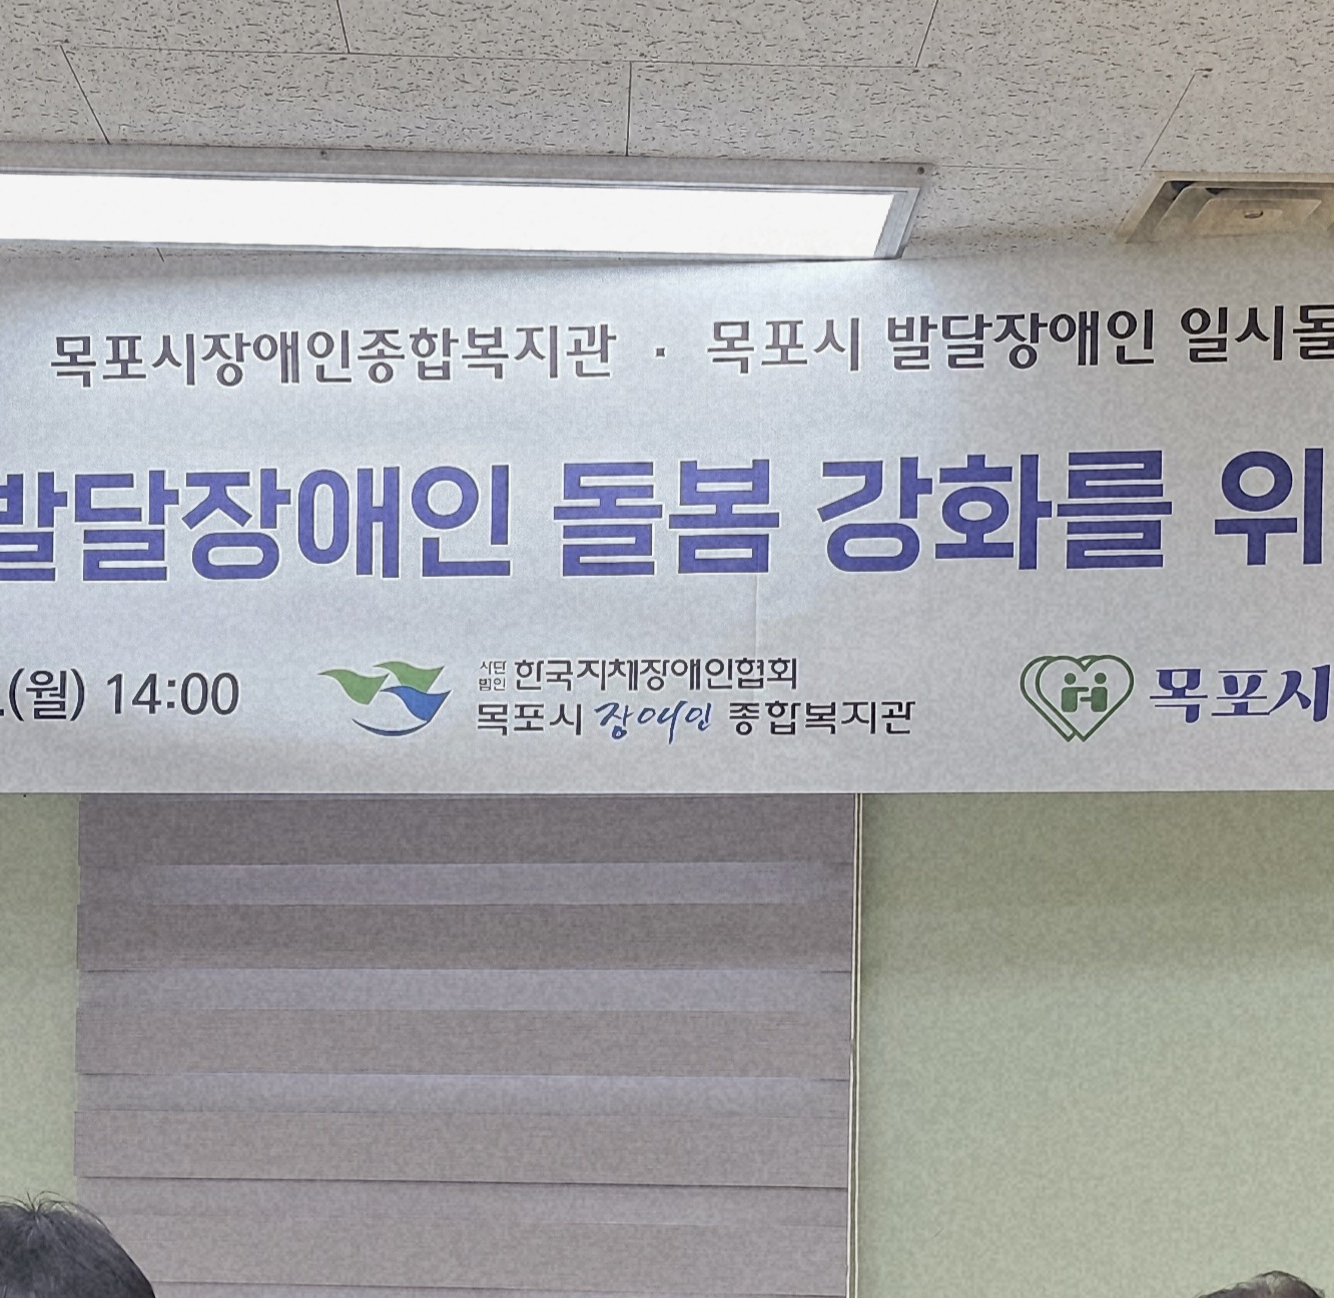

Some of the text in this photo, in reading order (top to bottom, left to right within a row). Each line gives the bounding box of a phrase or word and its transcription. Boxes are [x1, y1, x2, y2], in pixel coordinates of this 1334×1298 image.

[50, 320, 617, 388] 목포시장애인종합복지관
[706, 317, 860, 375] 목포시
[887, 307, 1155, 370] 발달장애인
[553, 458, 780, 577] 돌봄
[817, 449, 1173, 573] 강화를
[106, 671, 240, 716] 14:00
[514, 656, 798, 692] 한국지체장애인협회
[1148, 663, 1331, 724] 목포시
[477, 699, 917, 745] 목포시 장애인 종합복지관
